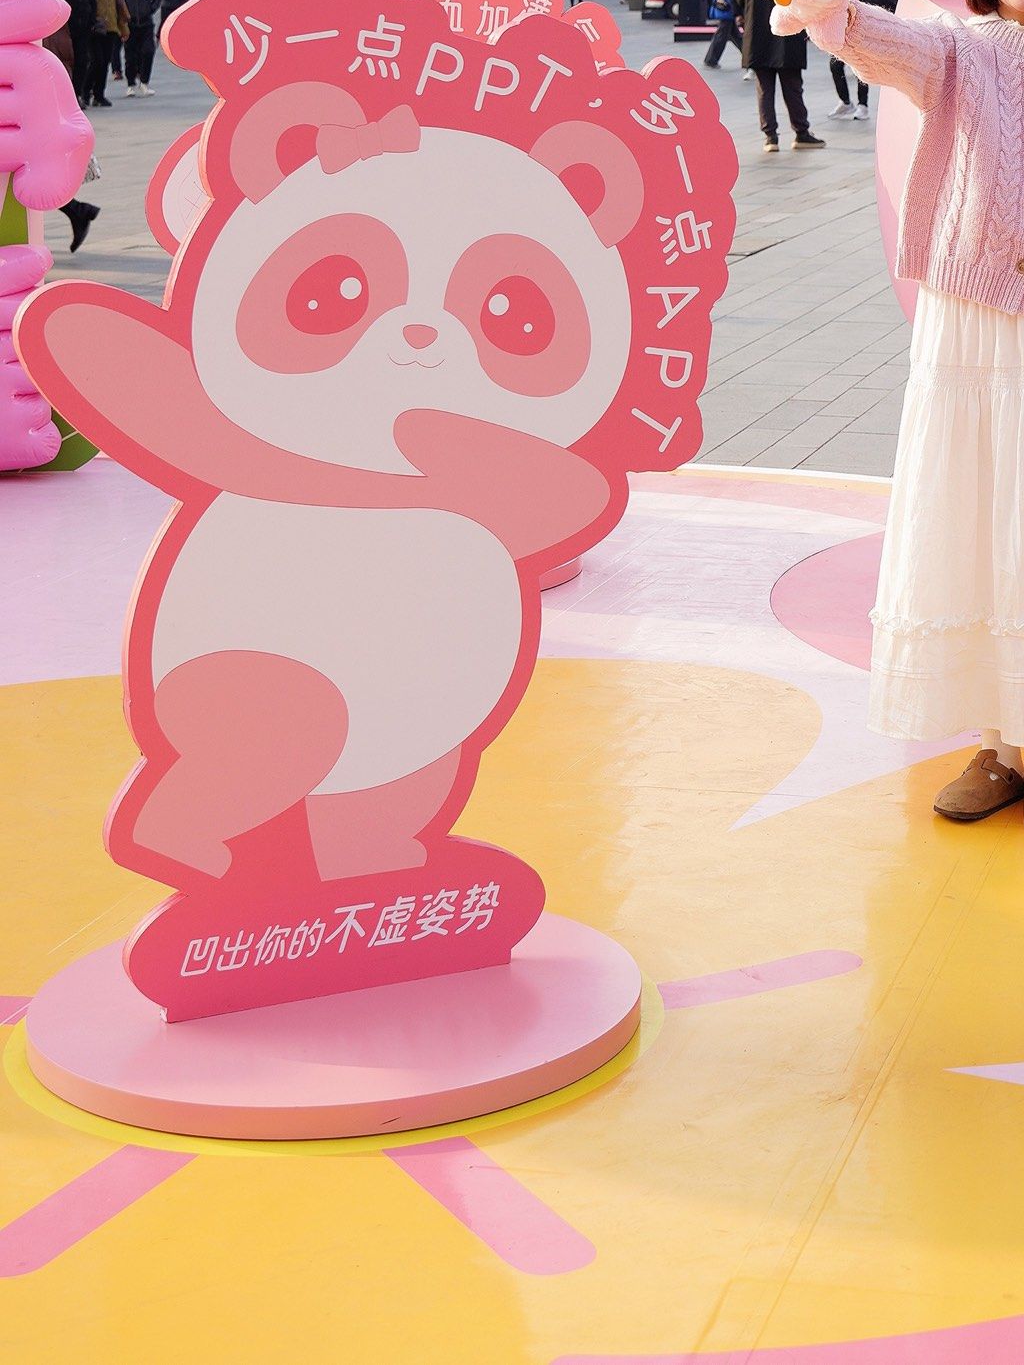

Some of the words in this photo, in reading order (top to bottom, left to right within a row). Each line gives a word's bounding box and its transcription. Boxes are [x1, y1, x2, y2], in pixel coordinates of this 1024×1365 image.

[180, 880, 501, 977] 凹出你的不虚姿势
